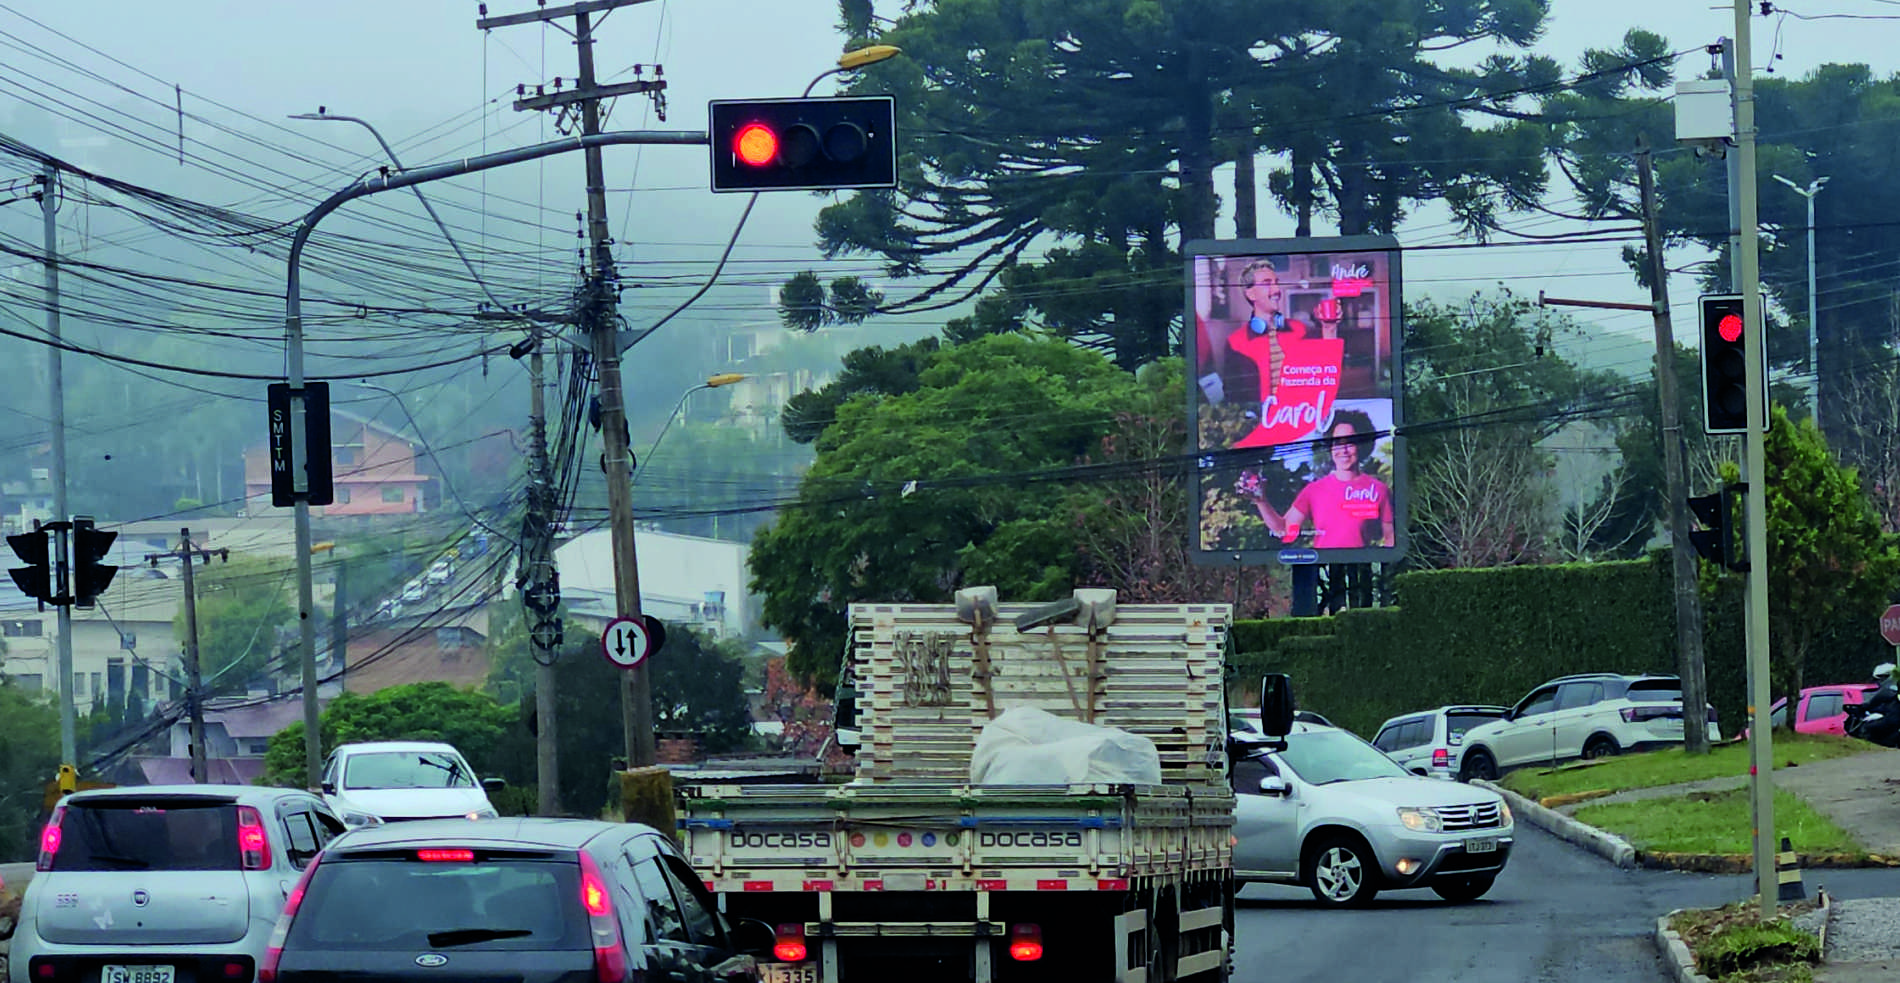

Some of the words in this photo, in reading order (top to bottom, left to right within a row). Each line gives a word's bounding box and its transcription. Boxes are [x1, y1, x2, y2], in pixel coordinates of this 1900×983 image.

[1331, 263, 1369, 280] André
[1283, 365, 1322, 376] Começa
[1324, 365, 1337, 374] na
[1322, 376, 1336, 386] da
[1261, 390, 1336, 433] Carol
[273, 409, 286, 472] SMTTM
[1345, 483, 1379, 502] Carol
[1884, 617, 1900, 633] PA
